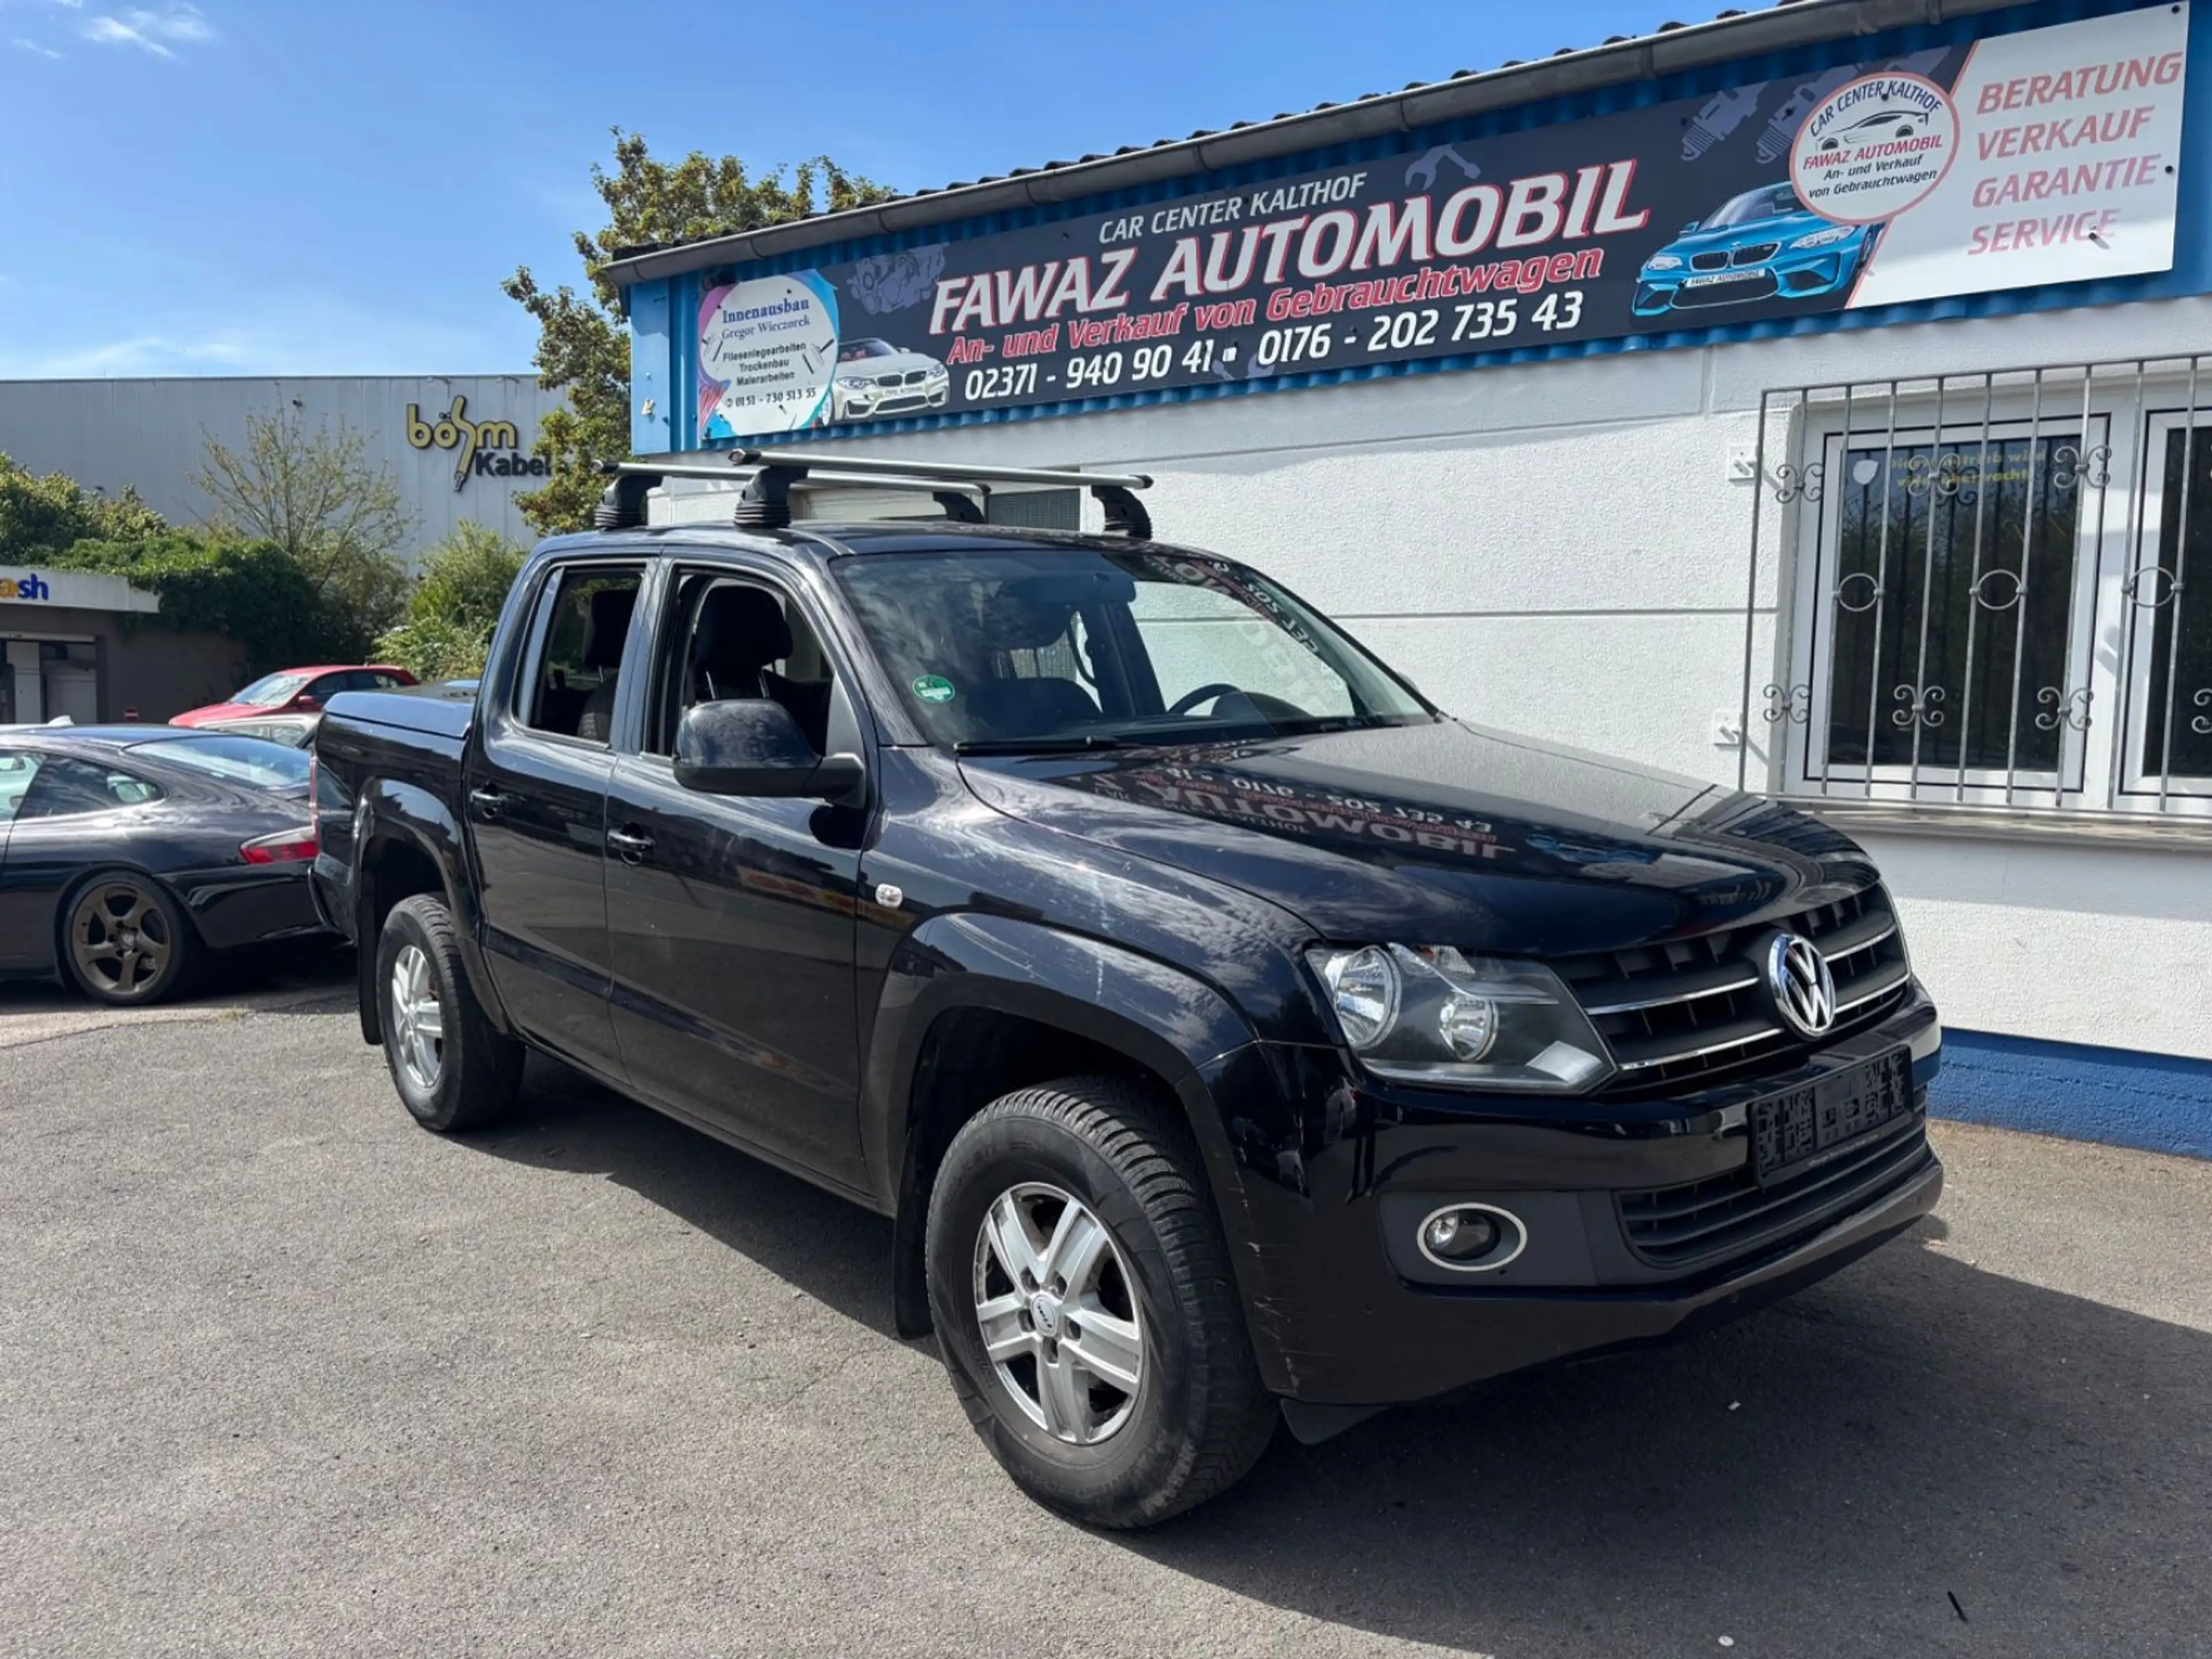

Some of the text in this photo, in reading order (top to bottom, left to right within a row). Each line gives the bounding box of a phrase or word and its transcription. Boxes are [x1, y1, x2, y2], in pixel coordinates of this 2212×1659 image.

[1976, 51, 2183, 115] BERATUNG
[1810, 80, 1943, 137] CAR CENTER KALTHOF
[1803, 135, 1943, 170] FAWAZ AUTOMOBIL
[1978, 105, 2156, 161] VERKAUF
[1809, 170, 1938, 199] von Gebrauchtwagen
[1824, 154, 1925, 181] An- und Verkauf
[1972, 153, 2162, 208] GARANTIE
[1099, 172, 1367, 244] CAR CENTER KALTHOF
[1968, 208, 2122, 256] SERVICE
[929, 158, 1650, 336] FAWAZ AUTOMOBIL
[721, 314, 811, 340] Gregor Wieczorek
[722, 297, 809, 323] Innenausbau
[947, 247, 1604, 365] An- und Verkauf von Gebrauchtwagen
[738, 358, 790, 372] Trockenbau
[965, 363, 1037, 400] 02371
[1067, 351, 1122, 389] 940
[1131, 344, 1172, 381] 90
[1182, 340, 1215, 374] 41
[1258, 323, 1332, 365] 0176
[1368, 309, 1439, 353] 202
[1450, 298, 1518, 342] 735
[1532, 290, 1583, 331] 43
[736, 372, 796, 386] Malerarbeiten
[476, 452, 552, 477] Kabel
